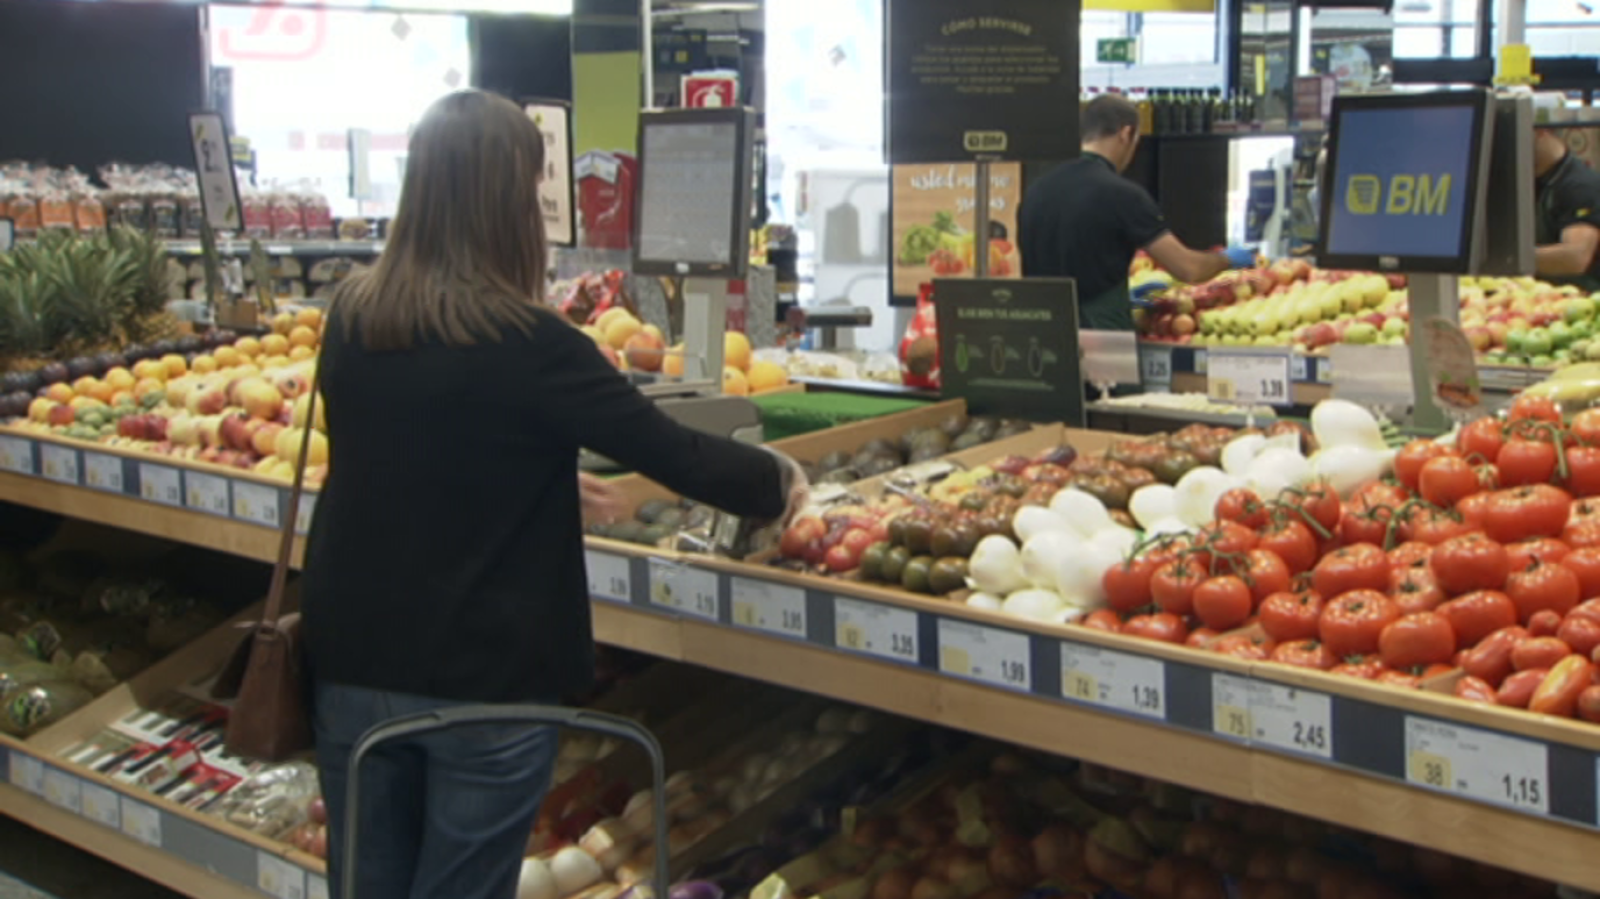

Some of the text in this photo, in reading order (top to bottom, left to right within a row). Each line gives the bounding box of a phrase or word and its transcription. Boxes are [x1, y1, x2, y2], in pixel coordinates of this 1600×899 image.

[1385, 173, 1452, 216] BM
[1132, 683, 1160, 710] 1,39
[1292, 720, 1325, 750] 2,45
[1424, 761, 1444, 787] 38
[1502, 773, 1540, 804] 1,15
